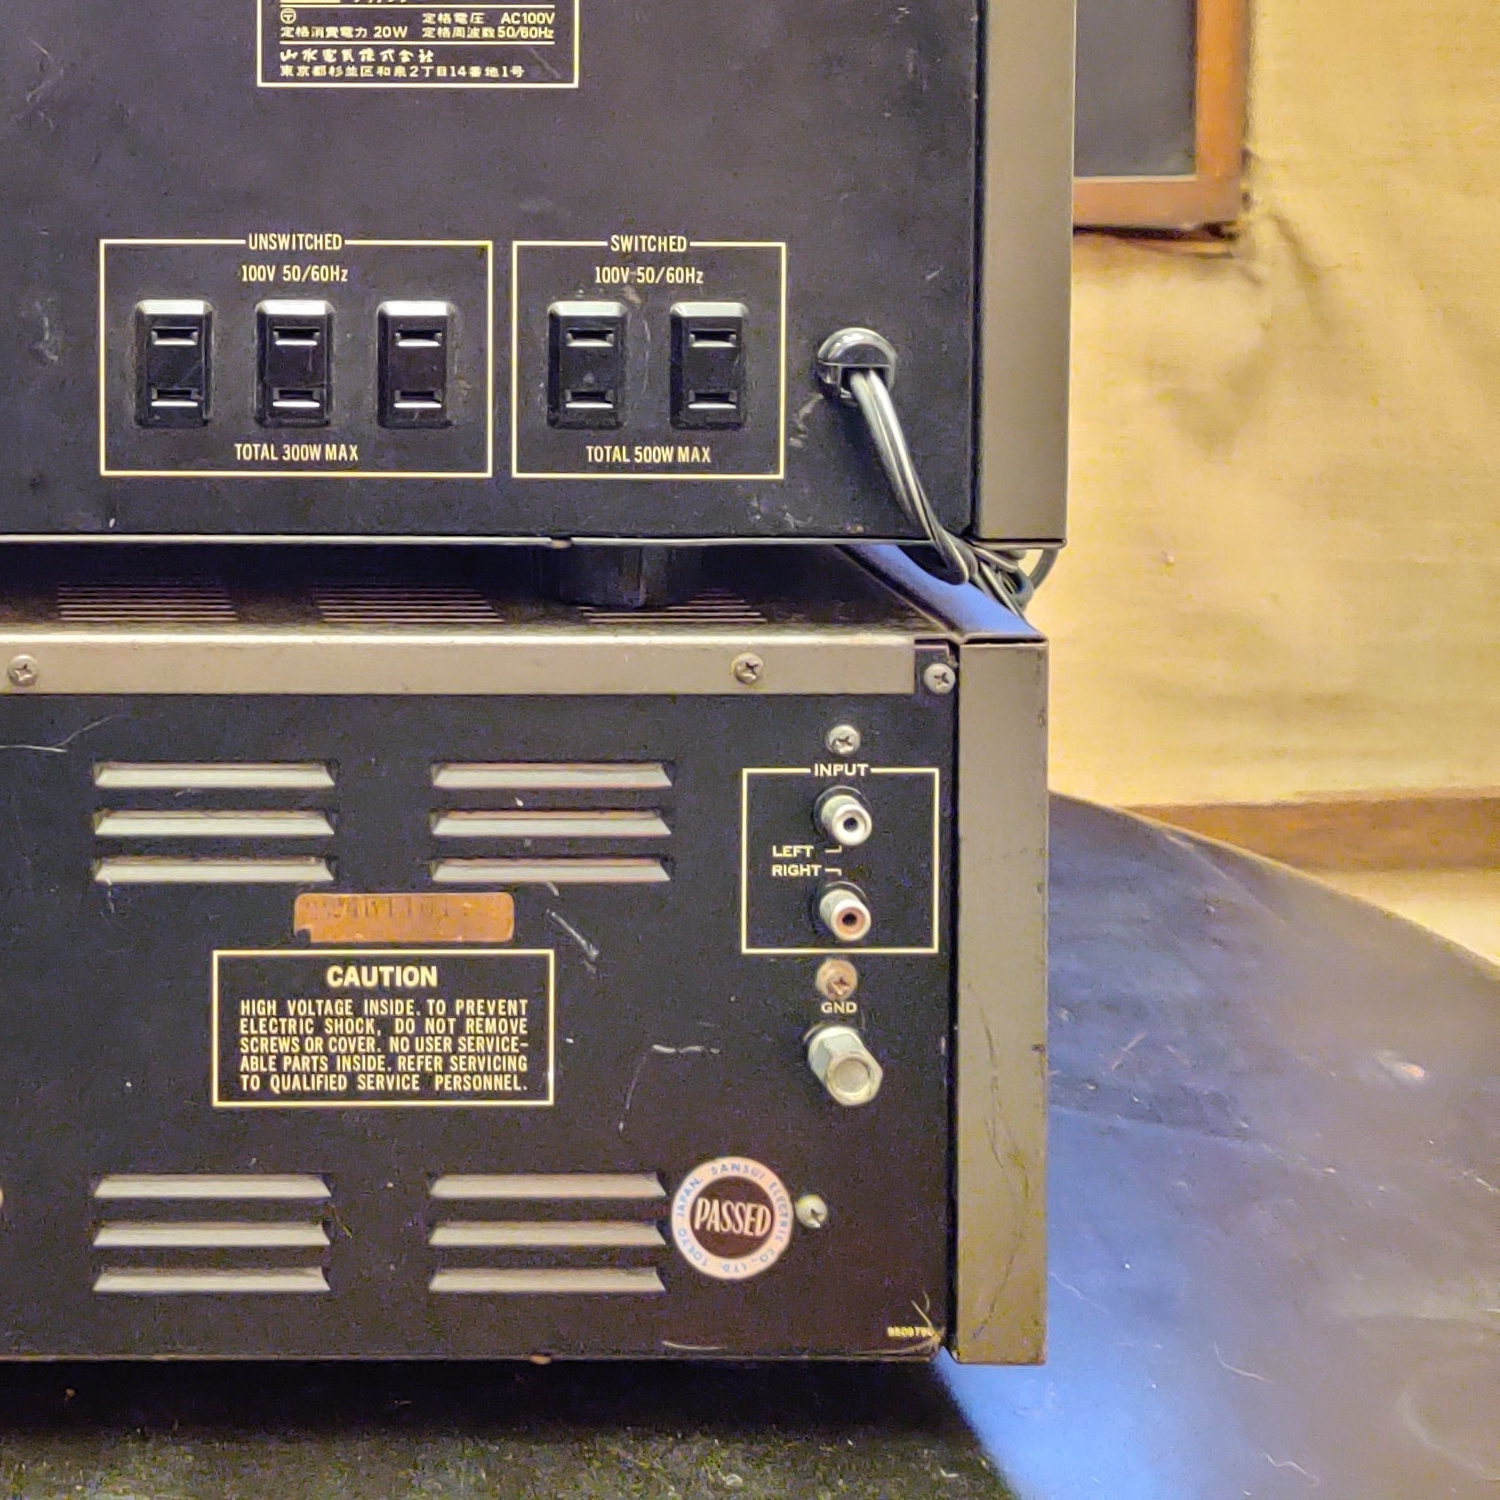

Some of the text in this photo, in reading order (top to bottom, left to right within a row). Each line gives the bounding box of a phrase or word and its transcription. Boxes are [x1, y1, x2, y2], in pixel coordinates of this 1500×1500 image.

[501, 12, 555, 25] AC100V
[374, 26, 408, 38] 20W
[497, 26, 555, 38] 50/60Hz
[248, 233, 343, 252] UNSWITCHED
[610, 235, 687, 253] SWITCHED
[241, 265, 349, 283] 100V 50/60Hz
[594, 267, 704, 285] 100V 50/60Hz
[235, 444, 359, 461] TOTAL 300W MAX
[585, 445, 711, 463] TOTAL 500W MAX
[814, 763, 869, 777] INPUT
[772, 845, 813, 858] LEFT
[771, 864, 822, 877] RIGHT
[327, 965, 438, 987] CAUTION
[240, 1000, 528, 1016] HIGH VOLTAGE INSIDE. TO PREVENT
[820, 1001, 858, 1014] GND
[240, 1018, 528, 1035] ELECTRIC SHOCK, DO NOT REMOVE
[240, 1036, 529, 1053] SCREWS OR COVER. NO USER SERVICE-
[240, 1055, 528, 1072] ABLE PARTS INSIDE. REFER SERVICING
[240, 1074, 528, 1092] TO QUALIFIED SERVICE PERSONNEL.
[694, 1197, 772, 1237] PASSED
